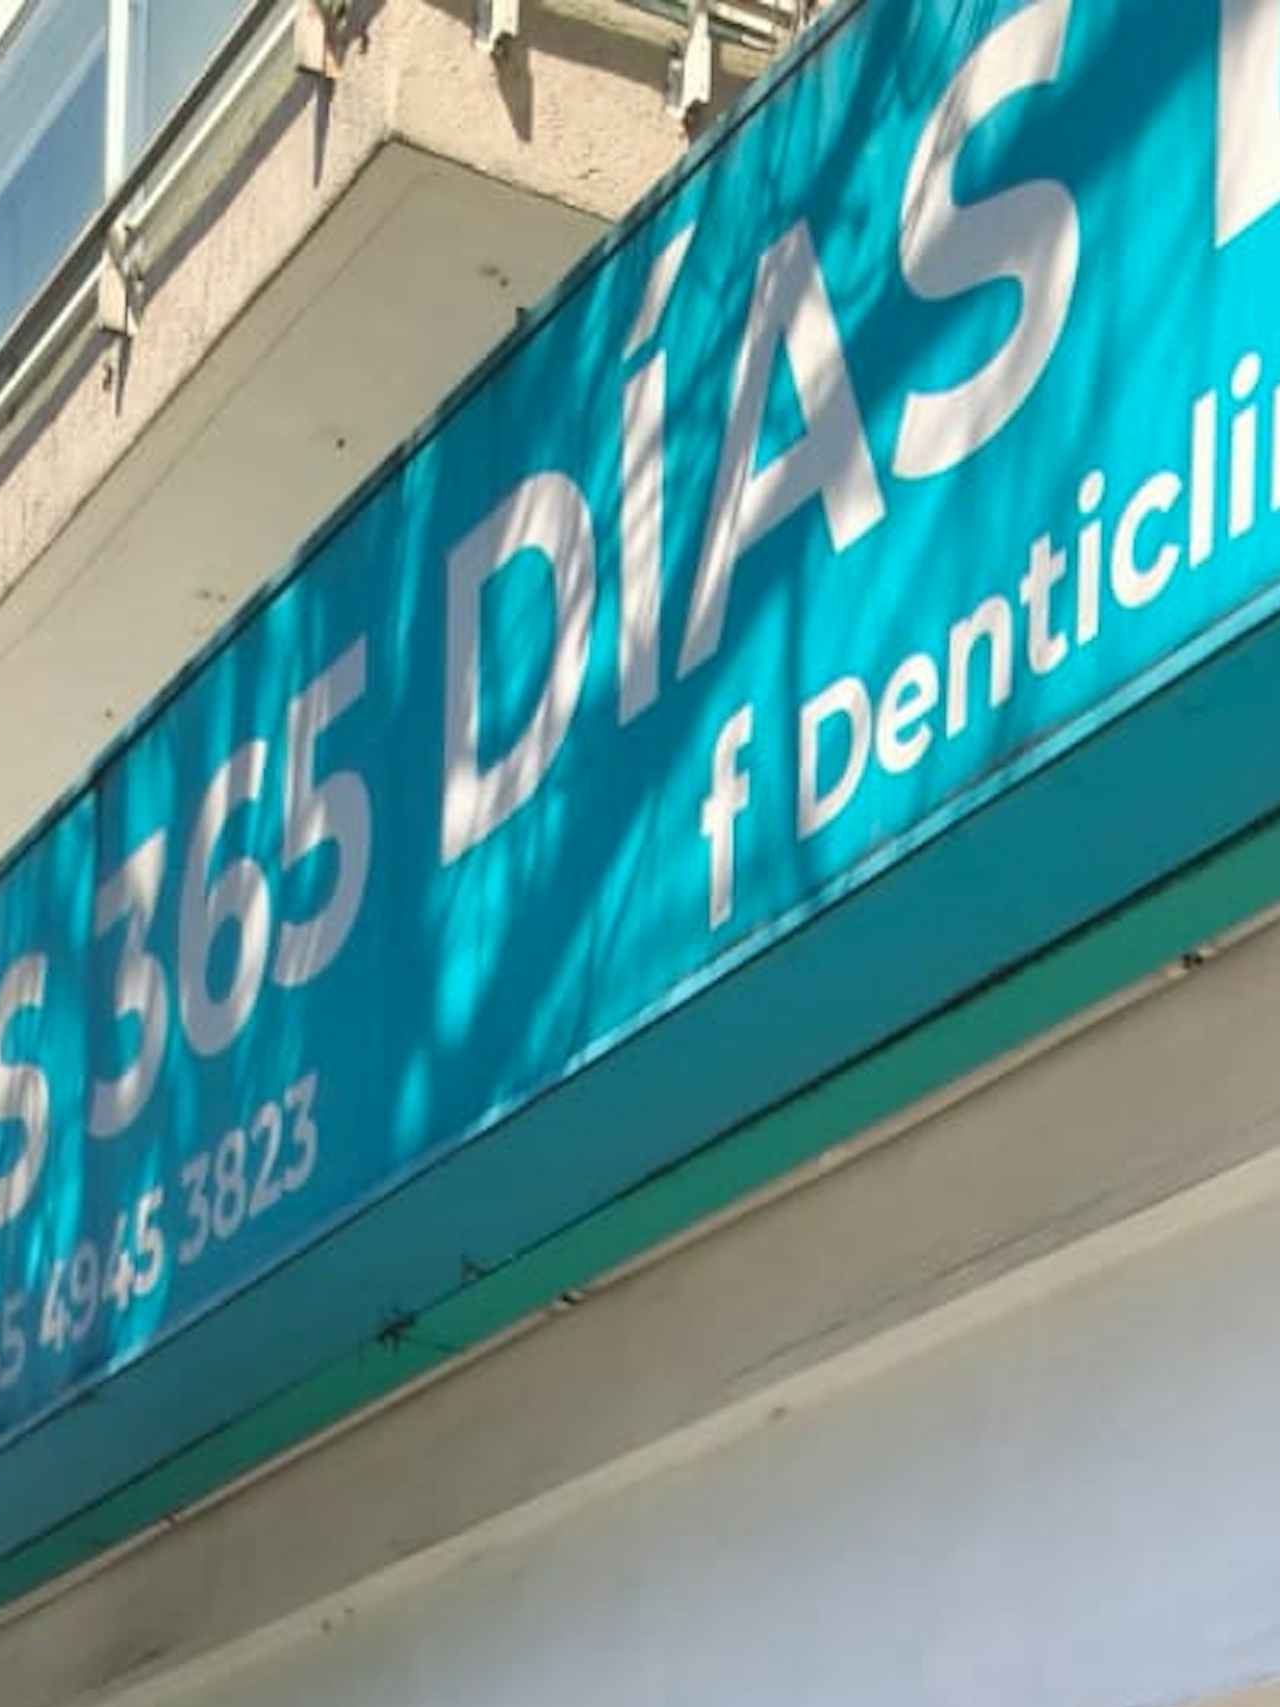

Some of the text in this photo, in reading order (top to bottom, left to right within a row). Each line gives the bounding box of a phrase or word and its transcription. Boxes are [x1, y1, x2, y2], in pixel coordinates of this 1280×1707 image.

[89, 635, 371, 1138] 365
[440, 0, 1081, 867] DÍAS
[39, 1186, 165, 1354] 4945
[178, 1073, 319, 1264] 3823
